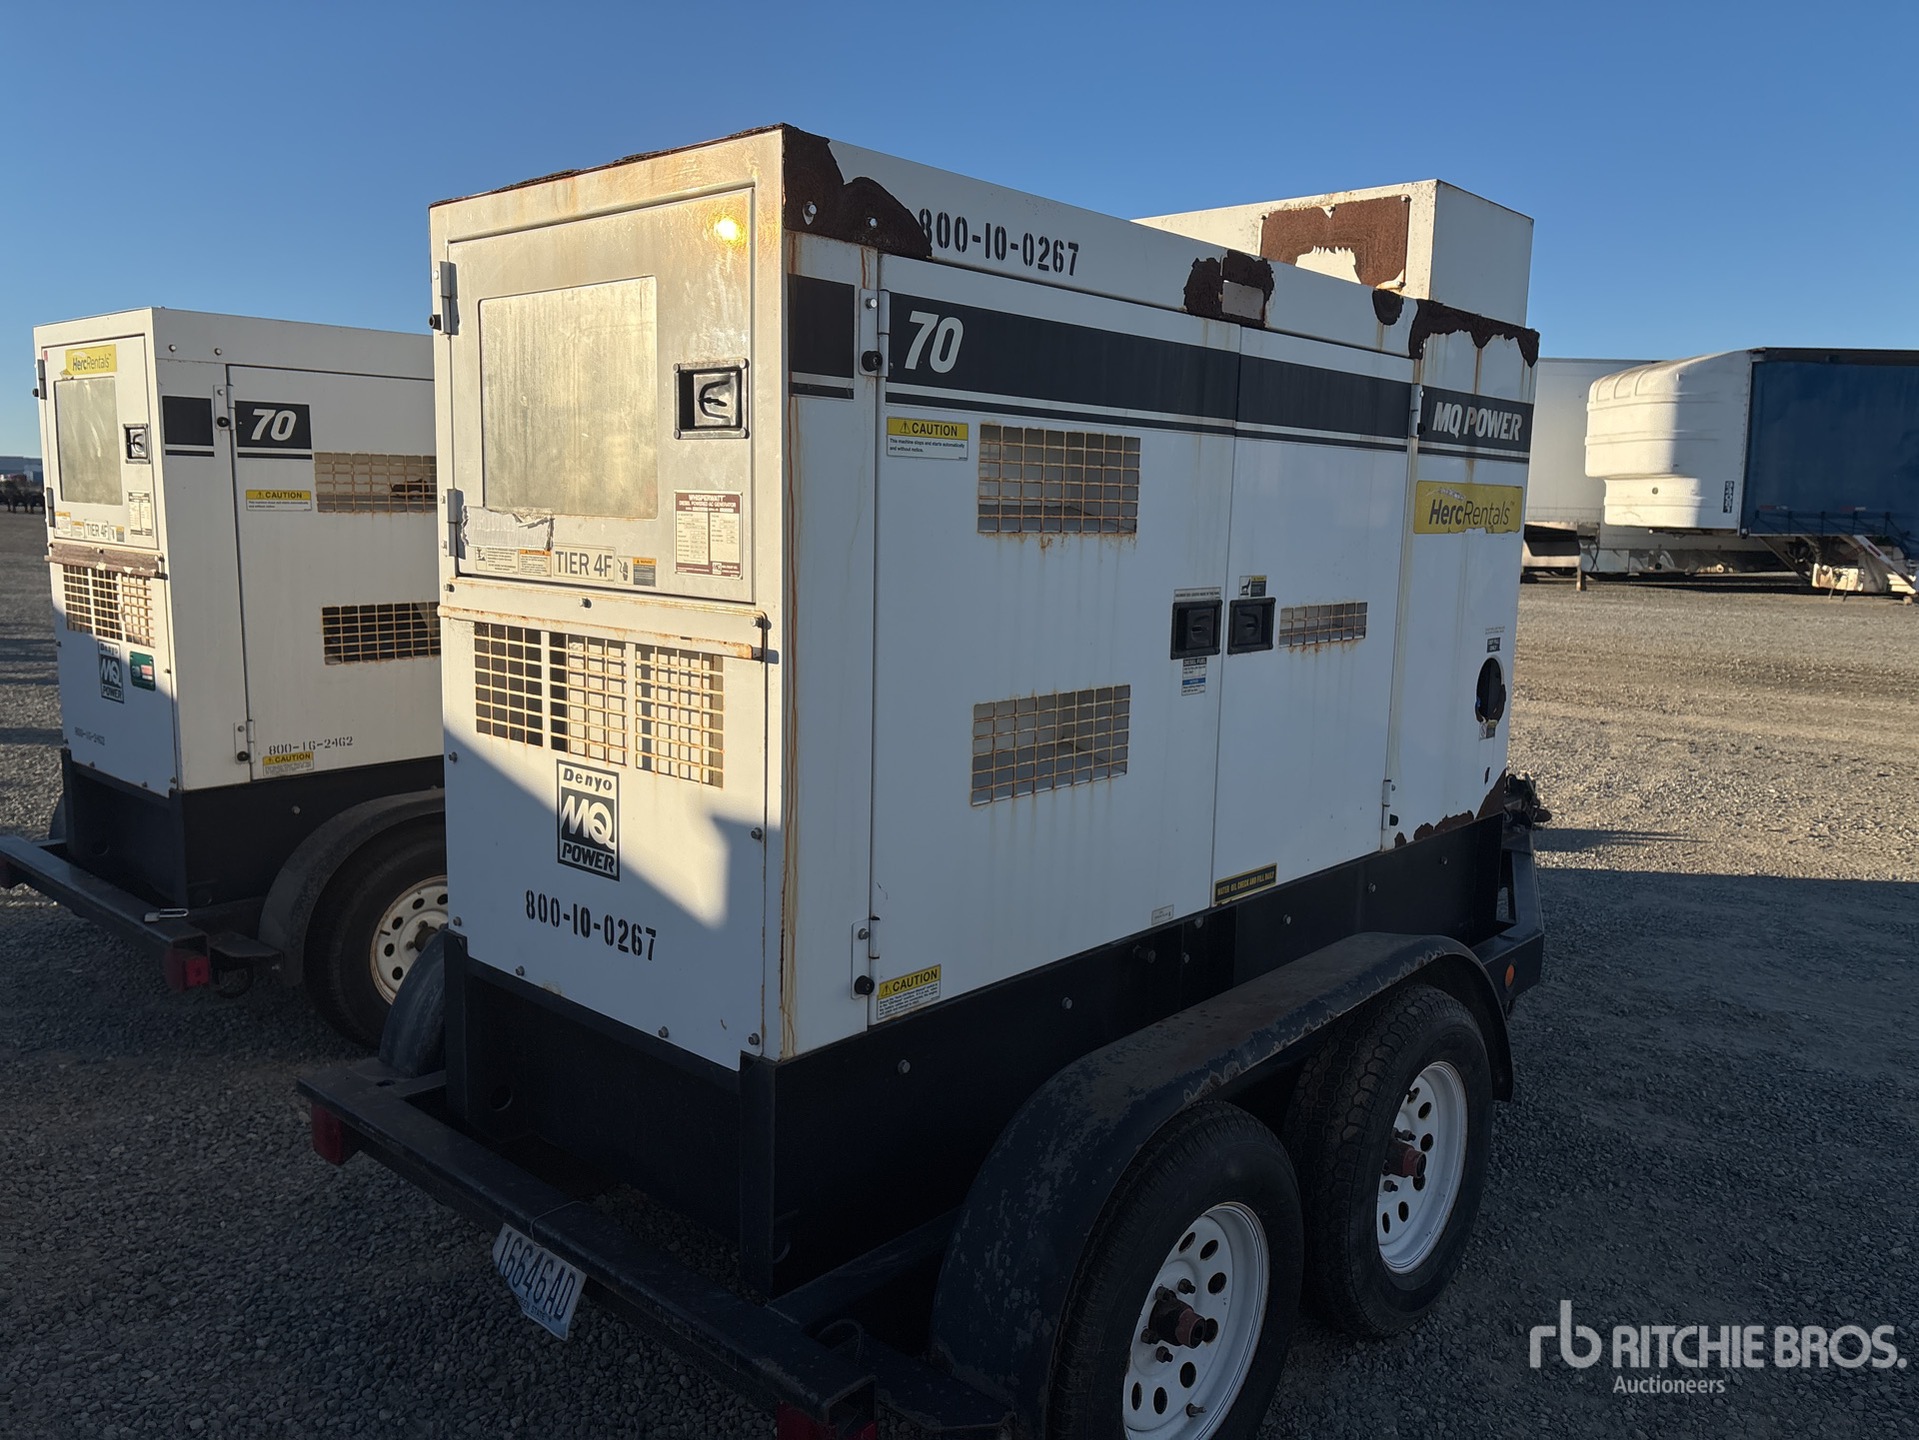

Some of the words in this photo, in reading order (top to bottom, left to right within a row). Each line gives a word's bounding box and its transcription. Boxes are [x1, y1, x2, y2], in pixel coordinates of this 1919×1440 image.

[919, 208, 1079, 276] 800-10-0267
[904, 310, 964, 373] 70
[250, 408, 297, 442] 70
[912, 422, 958, 437] CAUTION
[1432, 402, 1463, 439] MQ
[1463, 406, 1522, 441] POWER
[265, 491, 302, 499] CAUTION
[1428, 498, 1511, 526] HercRentals
[86, 523, 101, 537] TIER
[555, 550, 590, 576] TIER
[593, 554, 613, 577] 4F
[100, 658, 122, 687] MQ
[103, 685, 122, 698] POWER
[274, 752, 311, 764] CAUTION
[563, 767, 612, 792] Denyo
[561, 795, 615, 850] MQ
[561, 842, 615, 873] POWER
[525, 889, 657, 962] 800-10-0267
[892, 969, 938, 992] CAUTION
